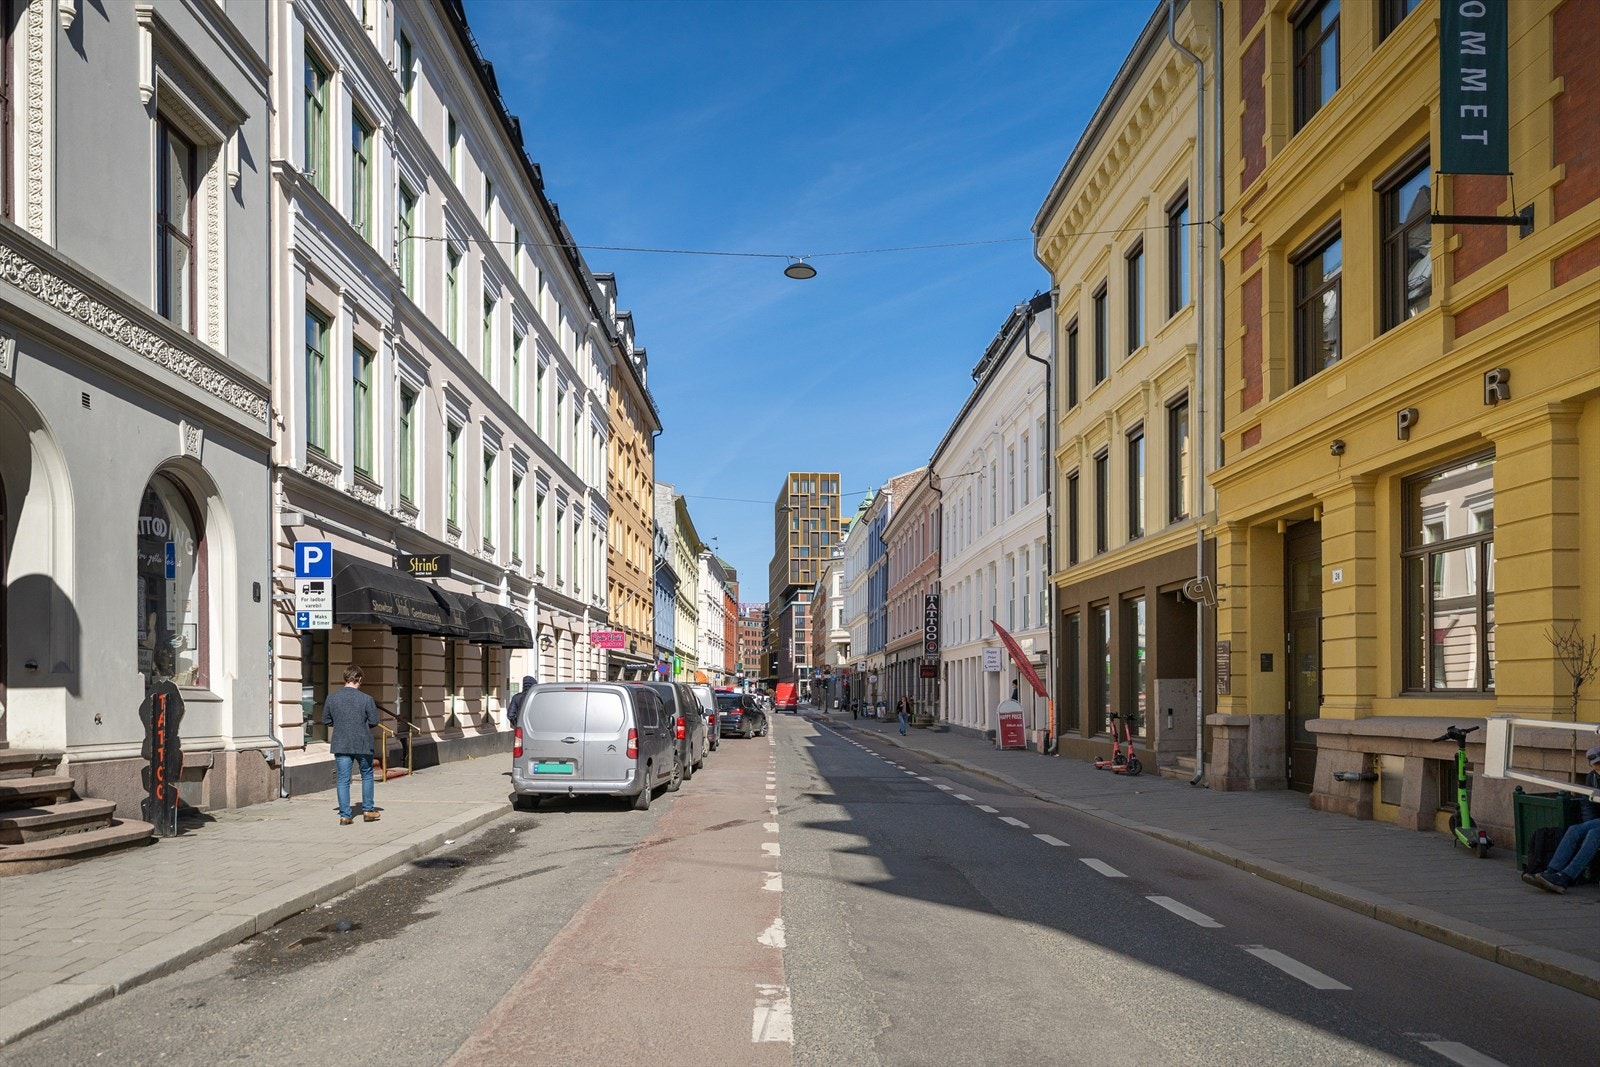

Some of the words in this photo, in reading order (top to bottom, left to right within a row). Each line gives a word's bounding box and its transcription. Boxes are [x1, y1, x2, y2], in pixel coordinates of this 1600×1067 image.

[138, 516, 193, 556] TTOOING
[304, 546, 323, 574] P
[926, 595, 938, 641] TATTOO
